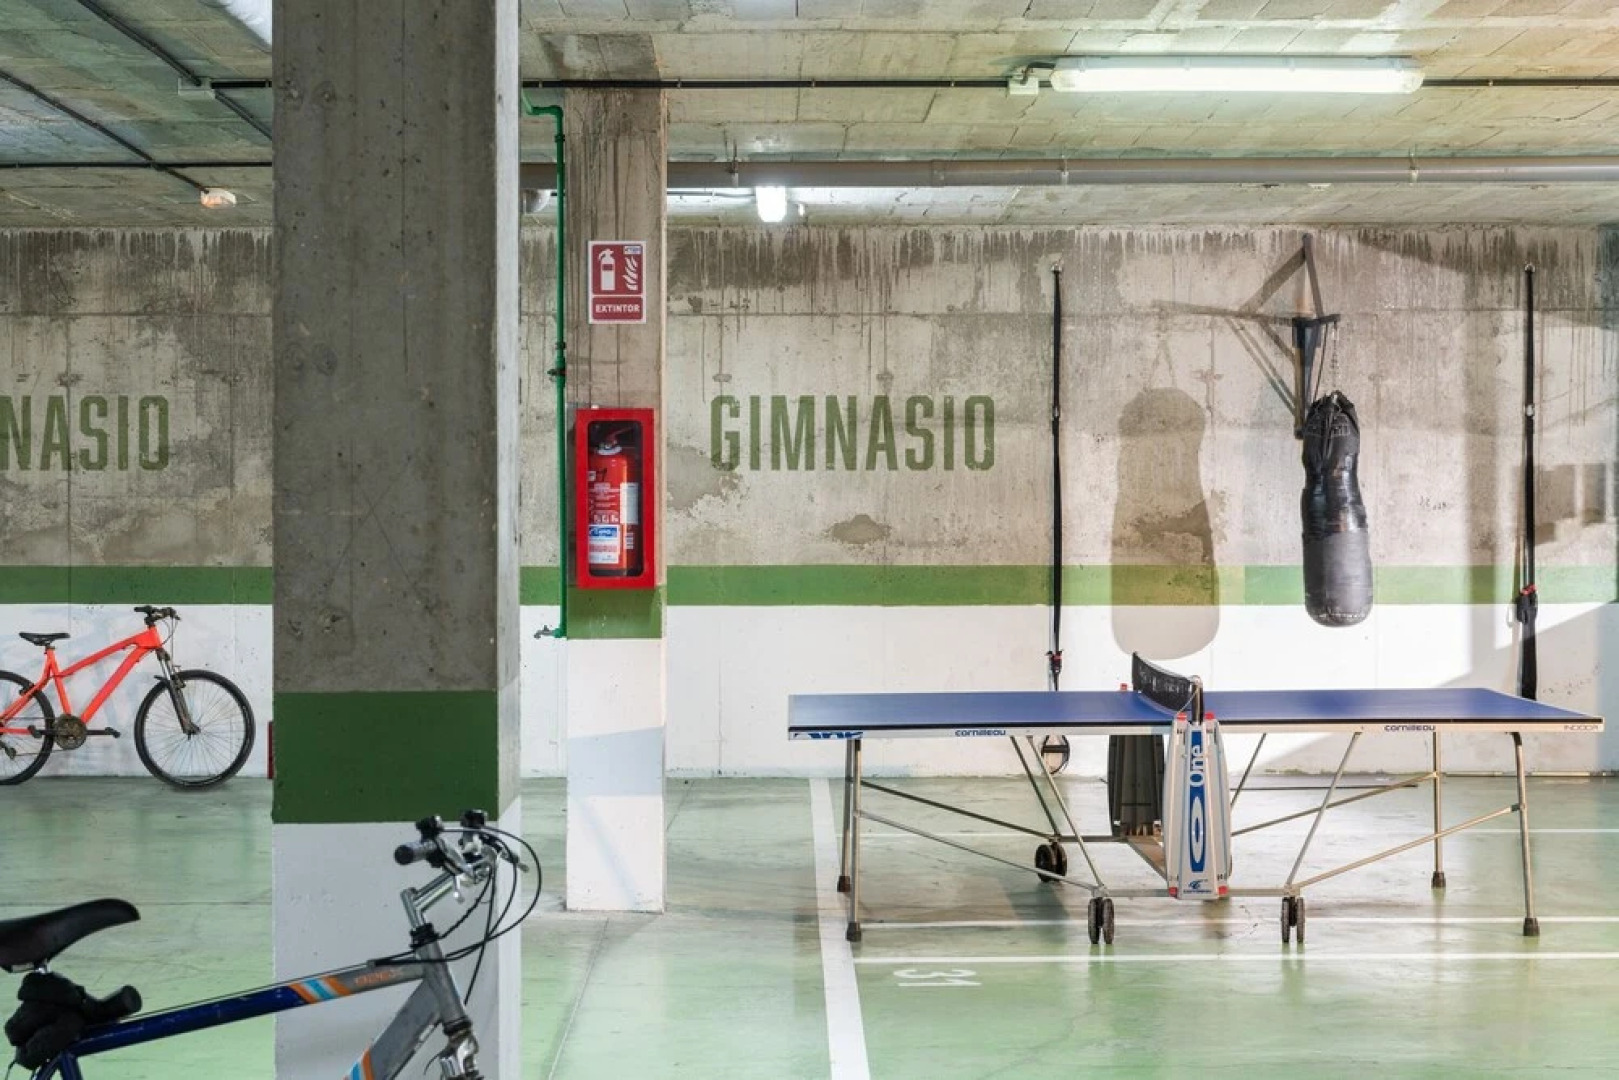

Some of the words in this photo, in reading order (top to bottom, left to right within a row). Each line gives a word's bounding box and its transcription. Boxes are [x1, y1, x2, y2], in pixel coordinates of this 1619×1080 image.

[595, 303, 641, 313] EXTINTOR
[0, 394, 169, 471] NASIO
[710, 394, 995, 471] GIMNASIO
[1190, 744, 1204, 788] One
